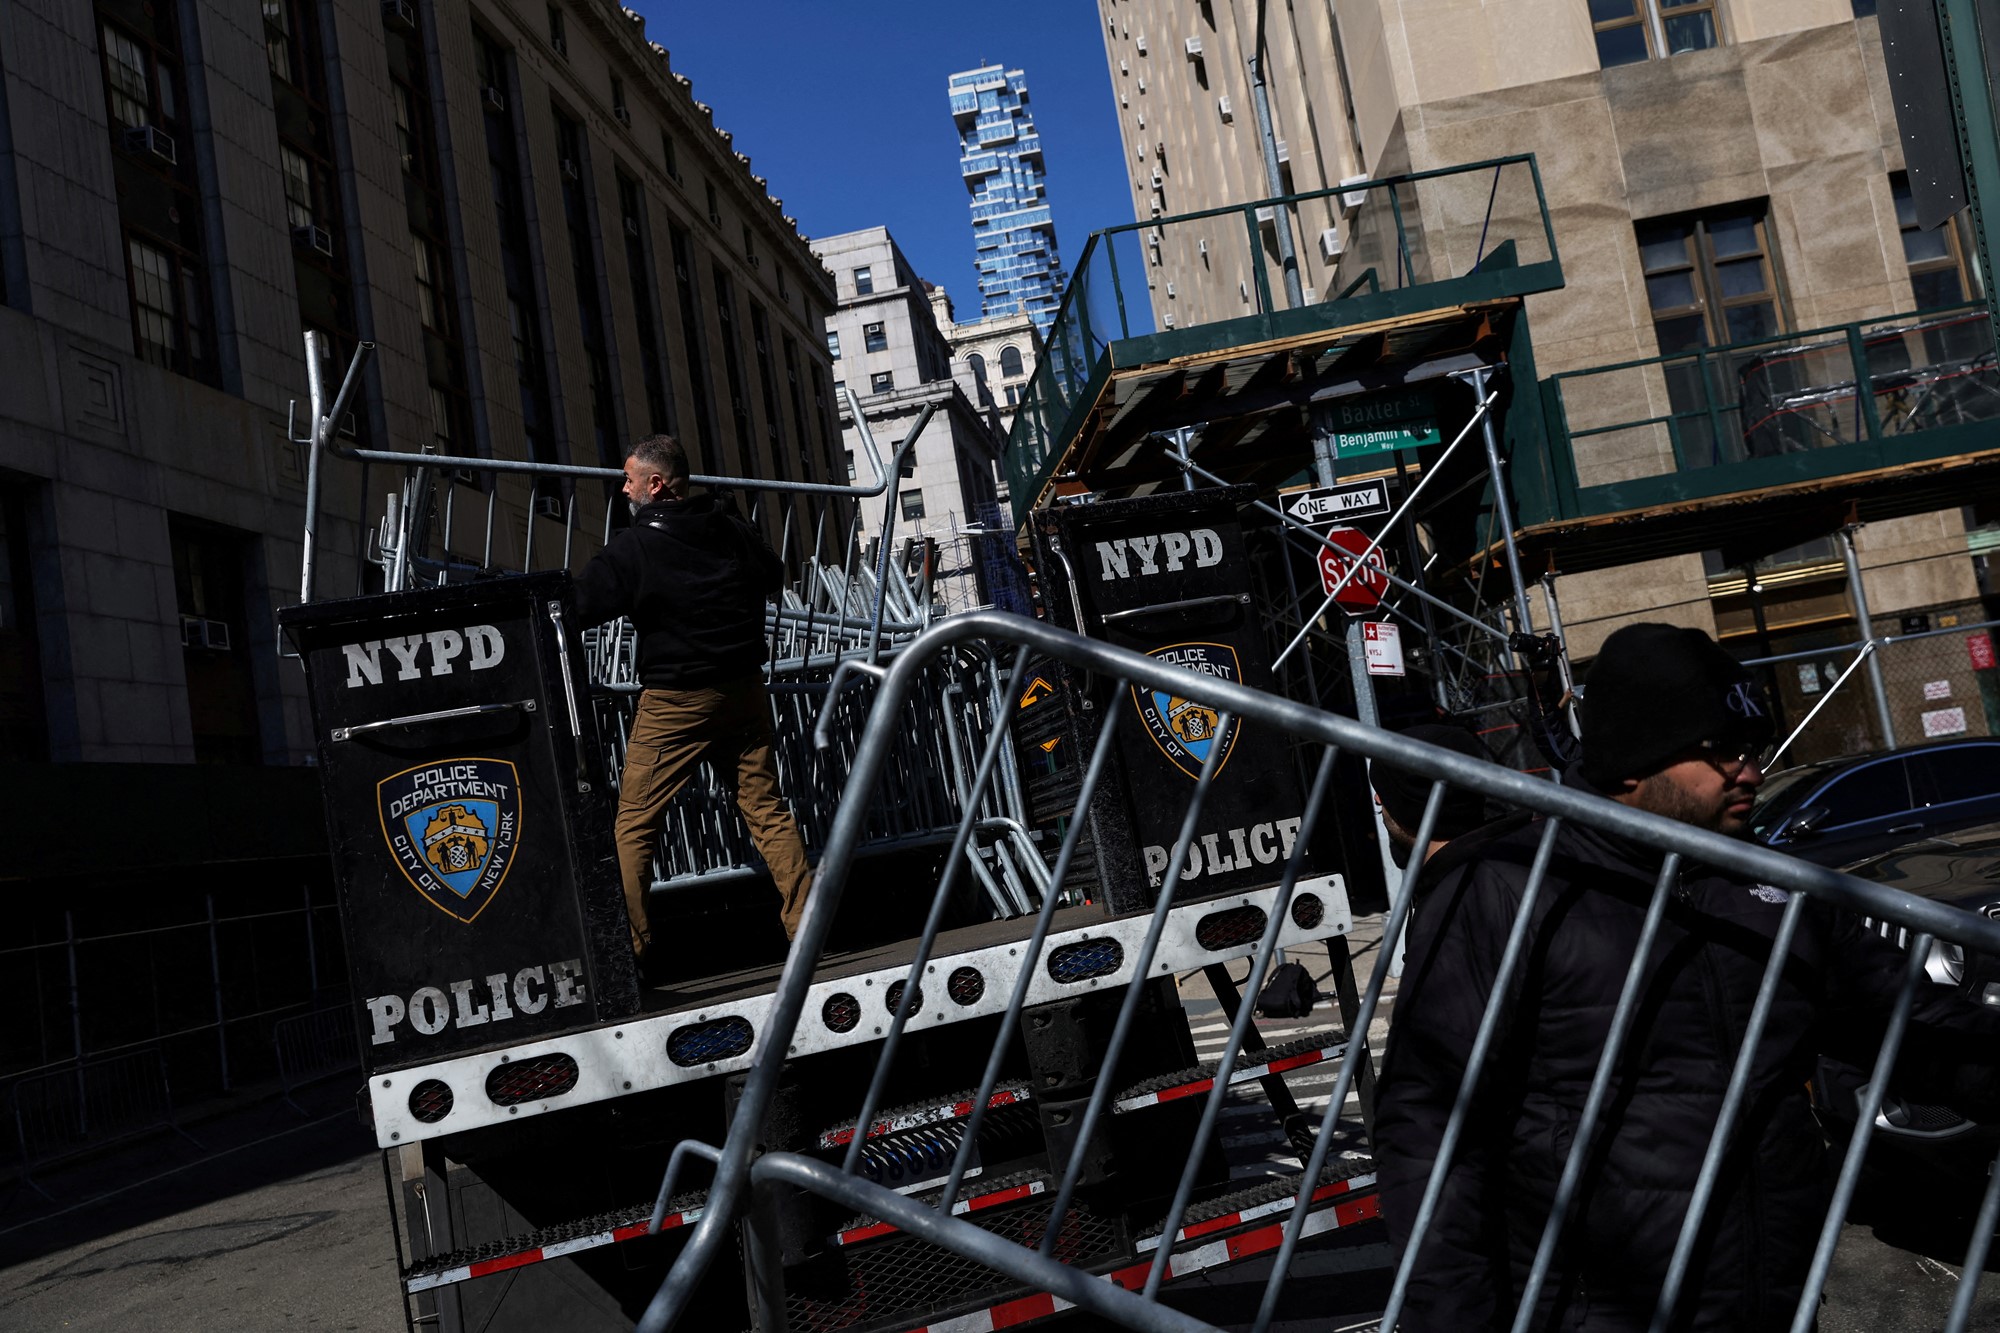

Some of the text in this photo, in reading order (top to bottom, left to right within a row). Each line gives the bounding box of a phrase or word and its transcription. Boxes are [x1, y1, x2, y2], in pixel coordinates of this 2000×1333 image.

[1341, 400, 1401, 425] Baxter
[1339, 422, 1432, 448] Benjamin Ward
[1380, 441, 1394, 450] Way
[1298, 499, 1328, 515] ONE
[1340, 491, 1372, 508] WAY
[1095, 528, 1224, 581] NYPD
[1324, 553, 1381, 589] STOP
[342, 624, 505, 688] NYPD
[1144, 707, 1184, 757] CITY OF
[413, 765, 480, 789] POLICE
[389, 781, 508, 819] DEPARTMENT
[393, 834, 442, 892] CITY OF
[481, 811, 514, 889] NEW YORK
[1143, 816, 1309, 888] POLICE
[366, 958, 586, 1046] POLICE
